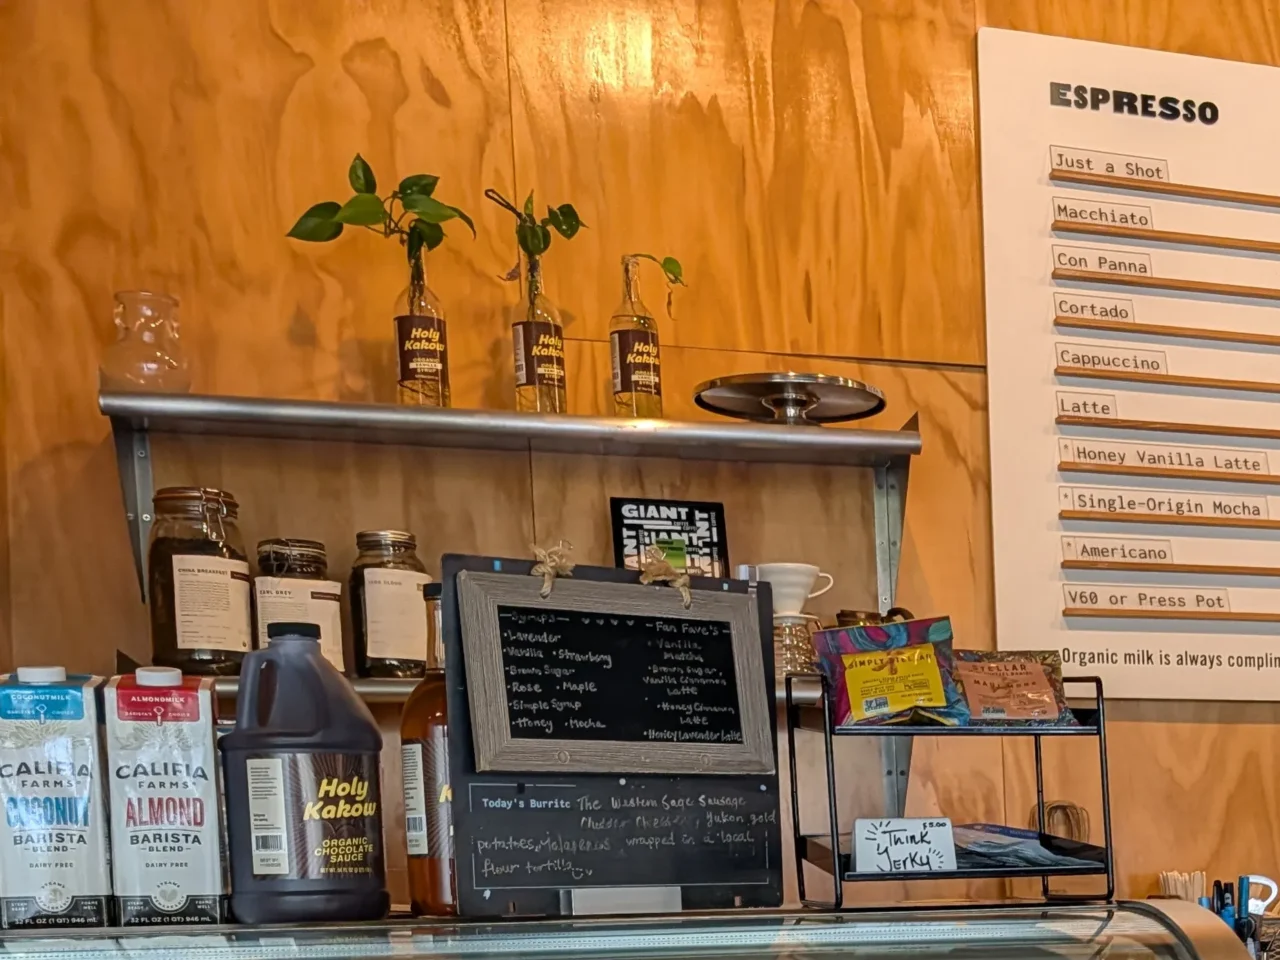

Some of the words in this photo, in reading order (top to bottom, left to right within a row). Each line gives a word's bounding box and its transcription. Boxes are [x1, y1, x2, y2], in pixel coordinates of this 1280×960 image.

[1049, 82, 1219, 125] ESPRESSO
[1055, 153, 1094, 171] Just
[1126, 162, 1164, 180] Shot
[1057, 204, 1149, 226] Macchiato
[1057, 253, 1088, 268] Con
[1098, 257, 1148, 274] Panna
[1059, 301, 1129, 320] Cortado
[411, 328, 440, 341] Holy
[539, 334, 562, 348] Holy
[404, 340, 444, 351] Kakow
[633, 342, 657, 355] Holy
[1060, 350, 1160, 371] Cappuccino
[1061, 399, 1111, 416] Latte
[1076, 446, 1126, 466] Honey
[1136, 451, 1205, 469] Vanilla
[1214, 456, 1261, 472] Latte
[621, 504, 688, 520] GIANT
[1077, 494, 1204, 516] Single-Origin
[1213, 500, 1261, 517] Mocha
[1081, 544, 1167, 561] Americano
[1068, 591, 1099, 606] V60
[1109, 594, 1127, 607] or
[1138, 593, 1186, 609] Press
[1196, 594, 1225, 610] Pot
[656, 621, 677, 633] Fan
[508, 630, 561, 643] Lavender
[507, 647, 543, 658] Vanilla
[1062, 648, 1118, 668] Organic
[1123, 649, 1154, 667] milk
[1159, 650, 1171, 668] is
[1176, 650, 1223, 670] always
[512, 682, 542, 692] Rose
[563, 682, 597, 694] Maple
[516, 717, 553, 733] Honey
[570, 717, 606, 728] Mocha
[116, 762, 208, 781] CALIFIA
[21, 780, 74, 788] FARMS
[138, 780, 189, 789] FARMS
[318, 776, 369, 798] Holy
[303, 799, 376, 821] Kakow
[482, 798, 524, 810] Today's
[577, 794, 602, 811] The
[6, 796, 91, 828] COCONUT
[126, 797, 205, 828] ALMOND
[751, 811, 776, 826] gold
[13, 833, 87, 846] BARISTA
[130, 833, 201, 845] BARISTA
[322, 837, 368, 847] ORGANIC
[314, 844, 373, 856] CHOCOLATE
[330, 853, 363, 863] SAUCE
